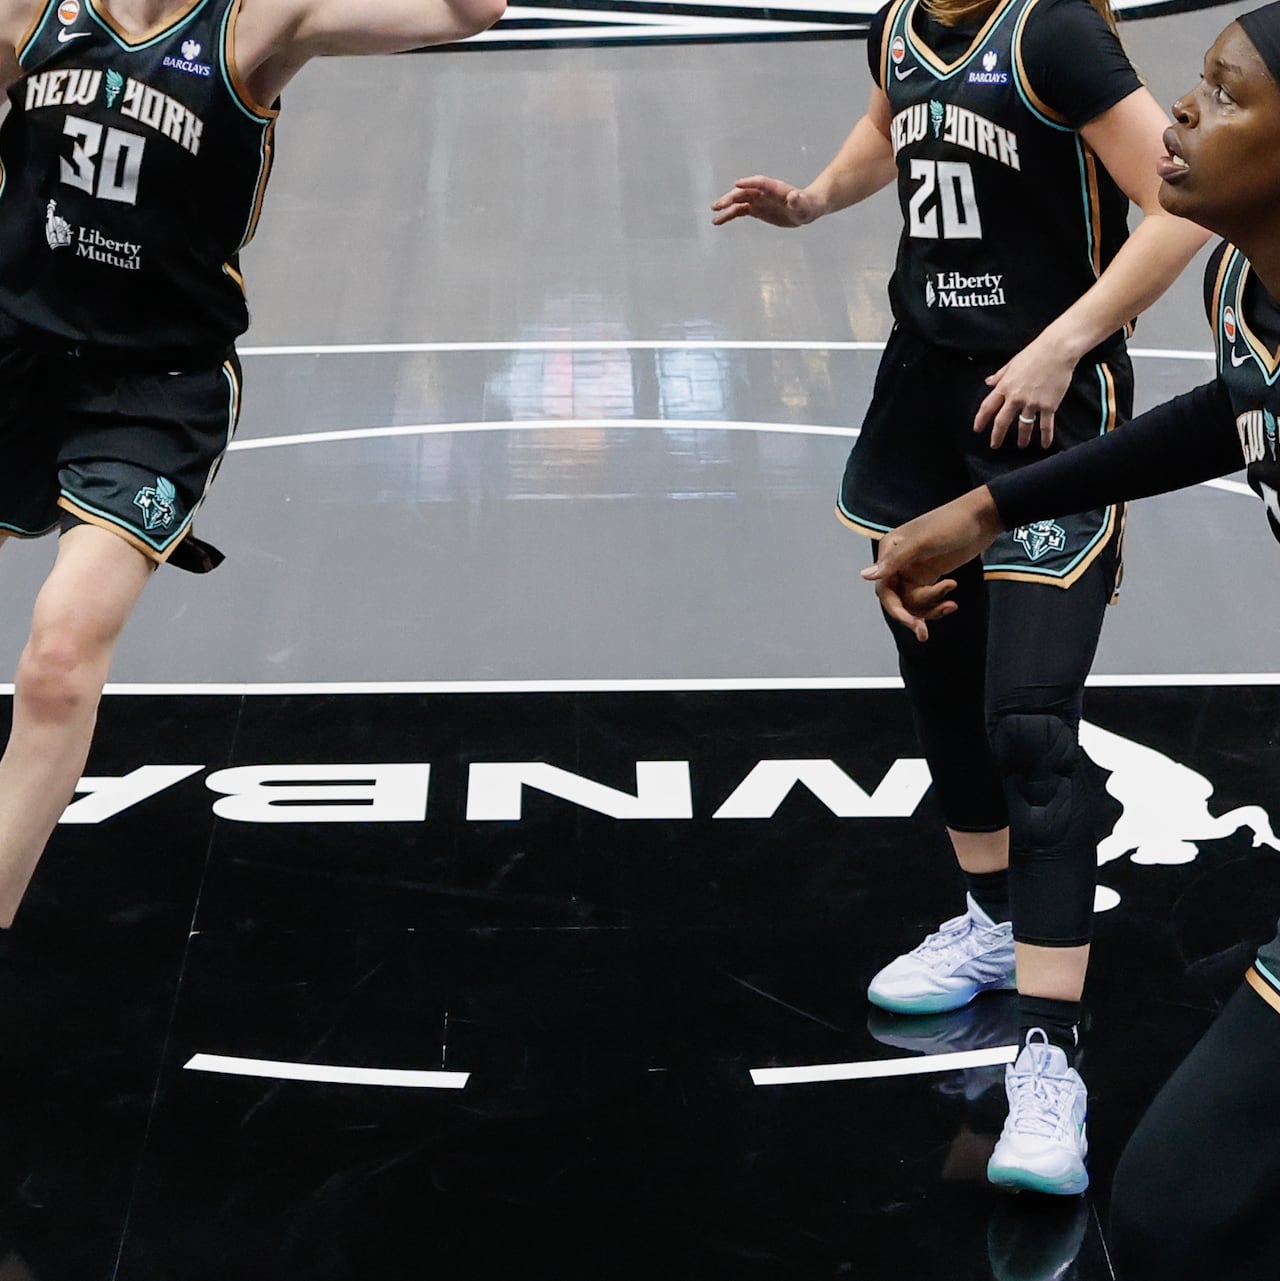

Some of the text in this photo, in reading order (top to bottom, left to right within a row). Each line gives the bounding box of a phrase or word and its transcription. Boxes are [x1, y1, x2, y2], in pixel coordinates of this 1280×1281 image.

[162, 56, 211, 77] BARCLAYS
[968, 71, 1009, 84] BARCLAYS
[24, 68, 205, 158] NEW YORK
[943, 103, 1021, 172] YORK
[59, 114, 147, 207] 30
[909, 158, 983, 240] 20
[75, 243, 141, 271] Mutual
[78, 226, 142, 261] Liberty
[935, 272, 1003, 292] Liberty
[936, 288, 1007, 309] Mutual
